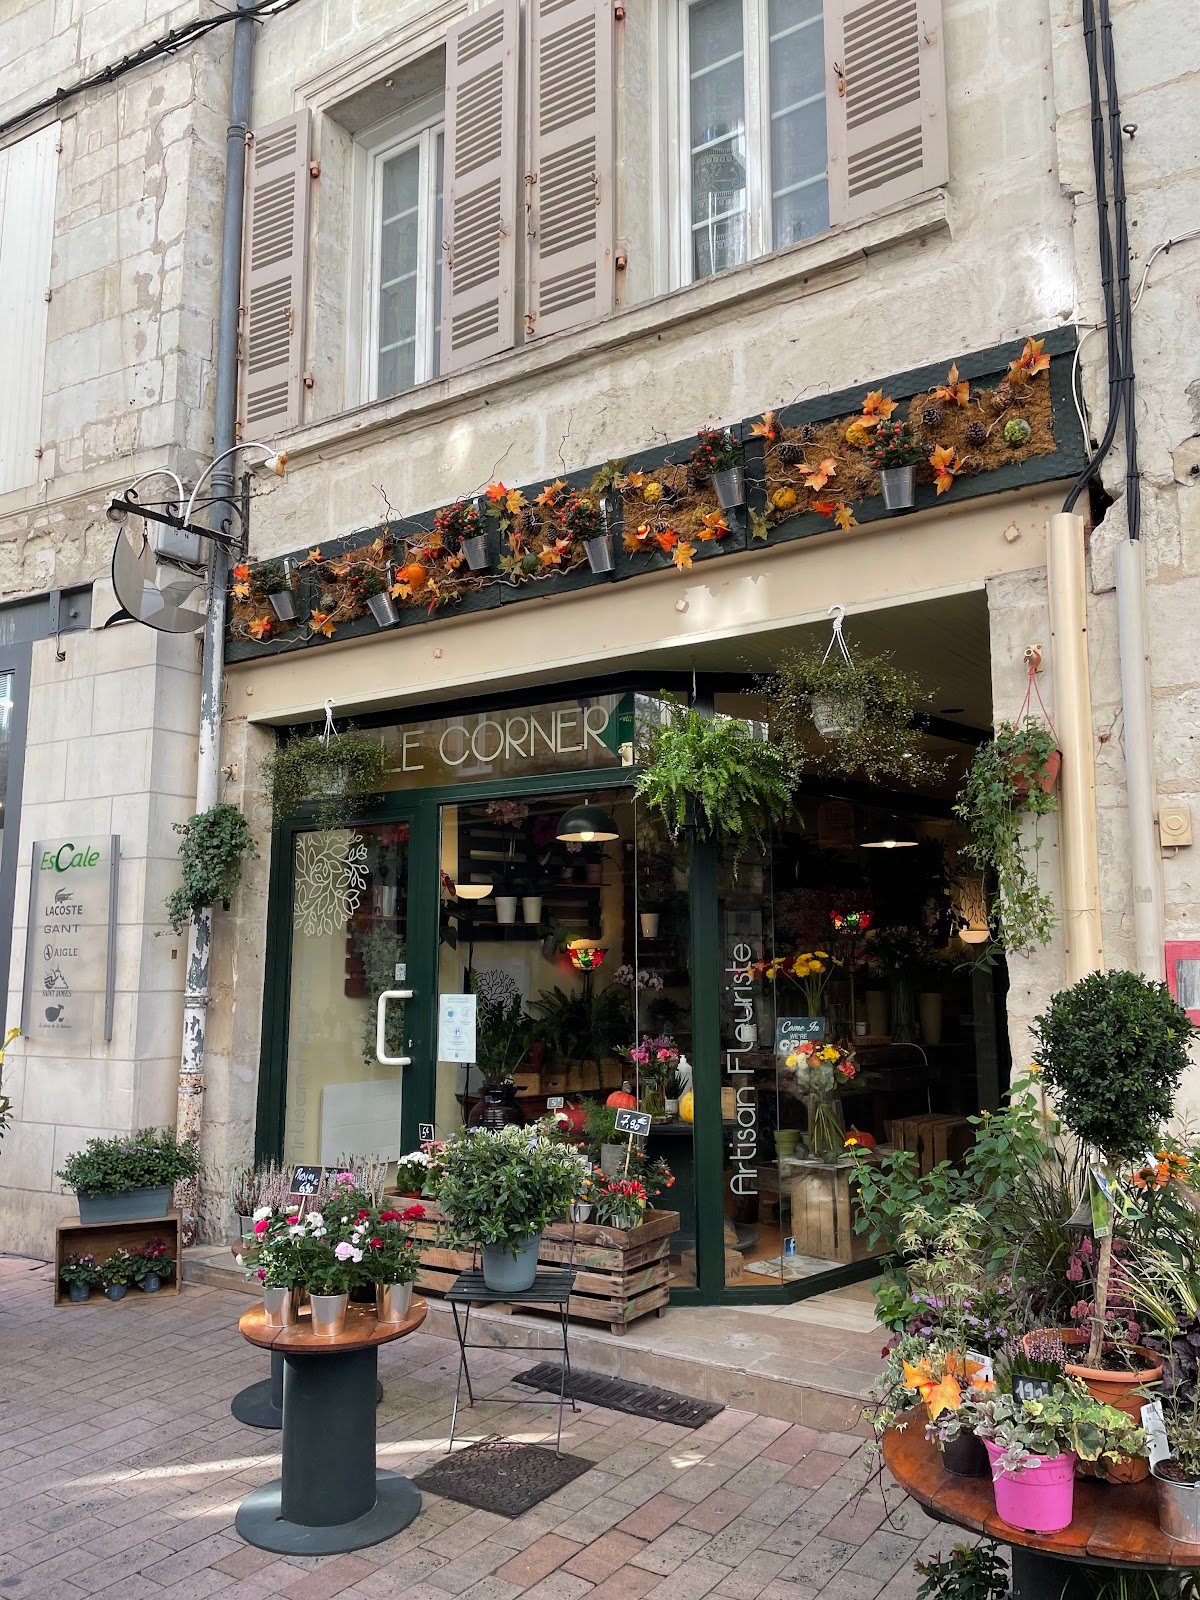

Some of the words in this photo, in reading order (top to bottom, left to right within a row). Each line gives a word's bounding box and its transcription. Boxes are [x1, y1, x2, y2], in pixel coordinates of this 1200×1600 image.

[380, 729, 425, 774] LE
[439, 705, 610, 767] CORNER
[40, 842, 100, 873] EsCale
[45, 904, 82, 917] LACOSTE
[43, 923, 81, 934] GANT
[53, 947, 78, 957] AIGLE
[724, 942, 757, 1075] Fleuriste
[781, 1020, 806, 1034] Come
[806, 1021, 820, 1032] In
[728, 1085, 758, 1196] Artisan
